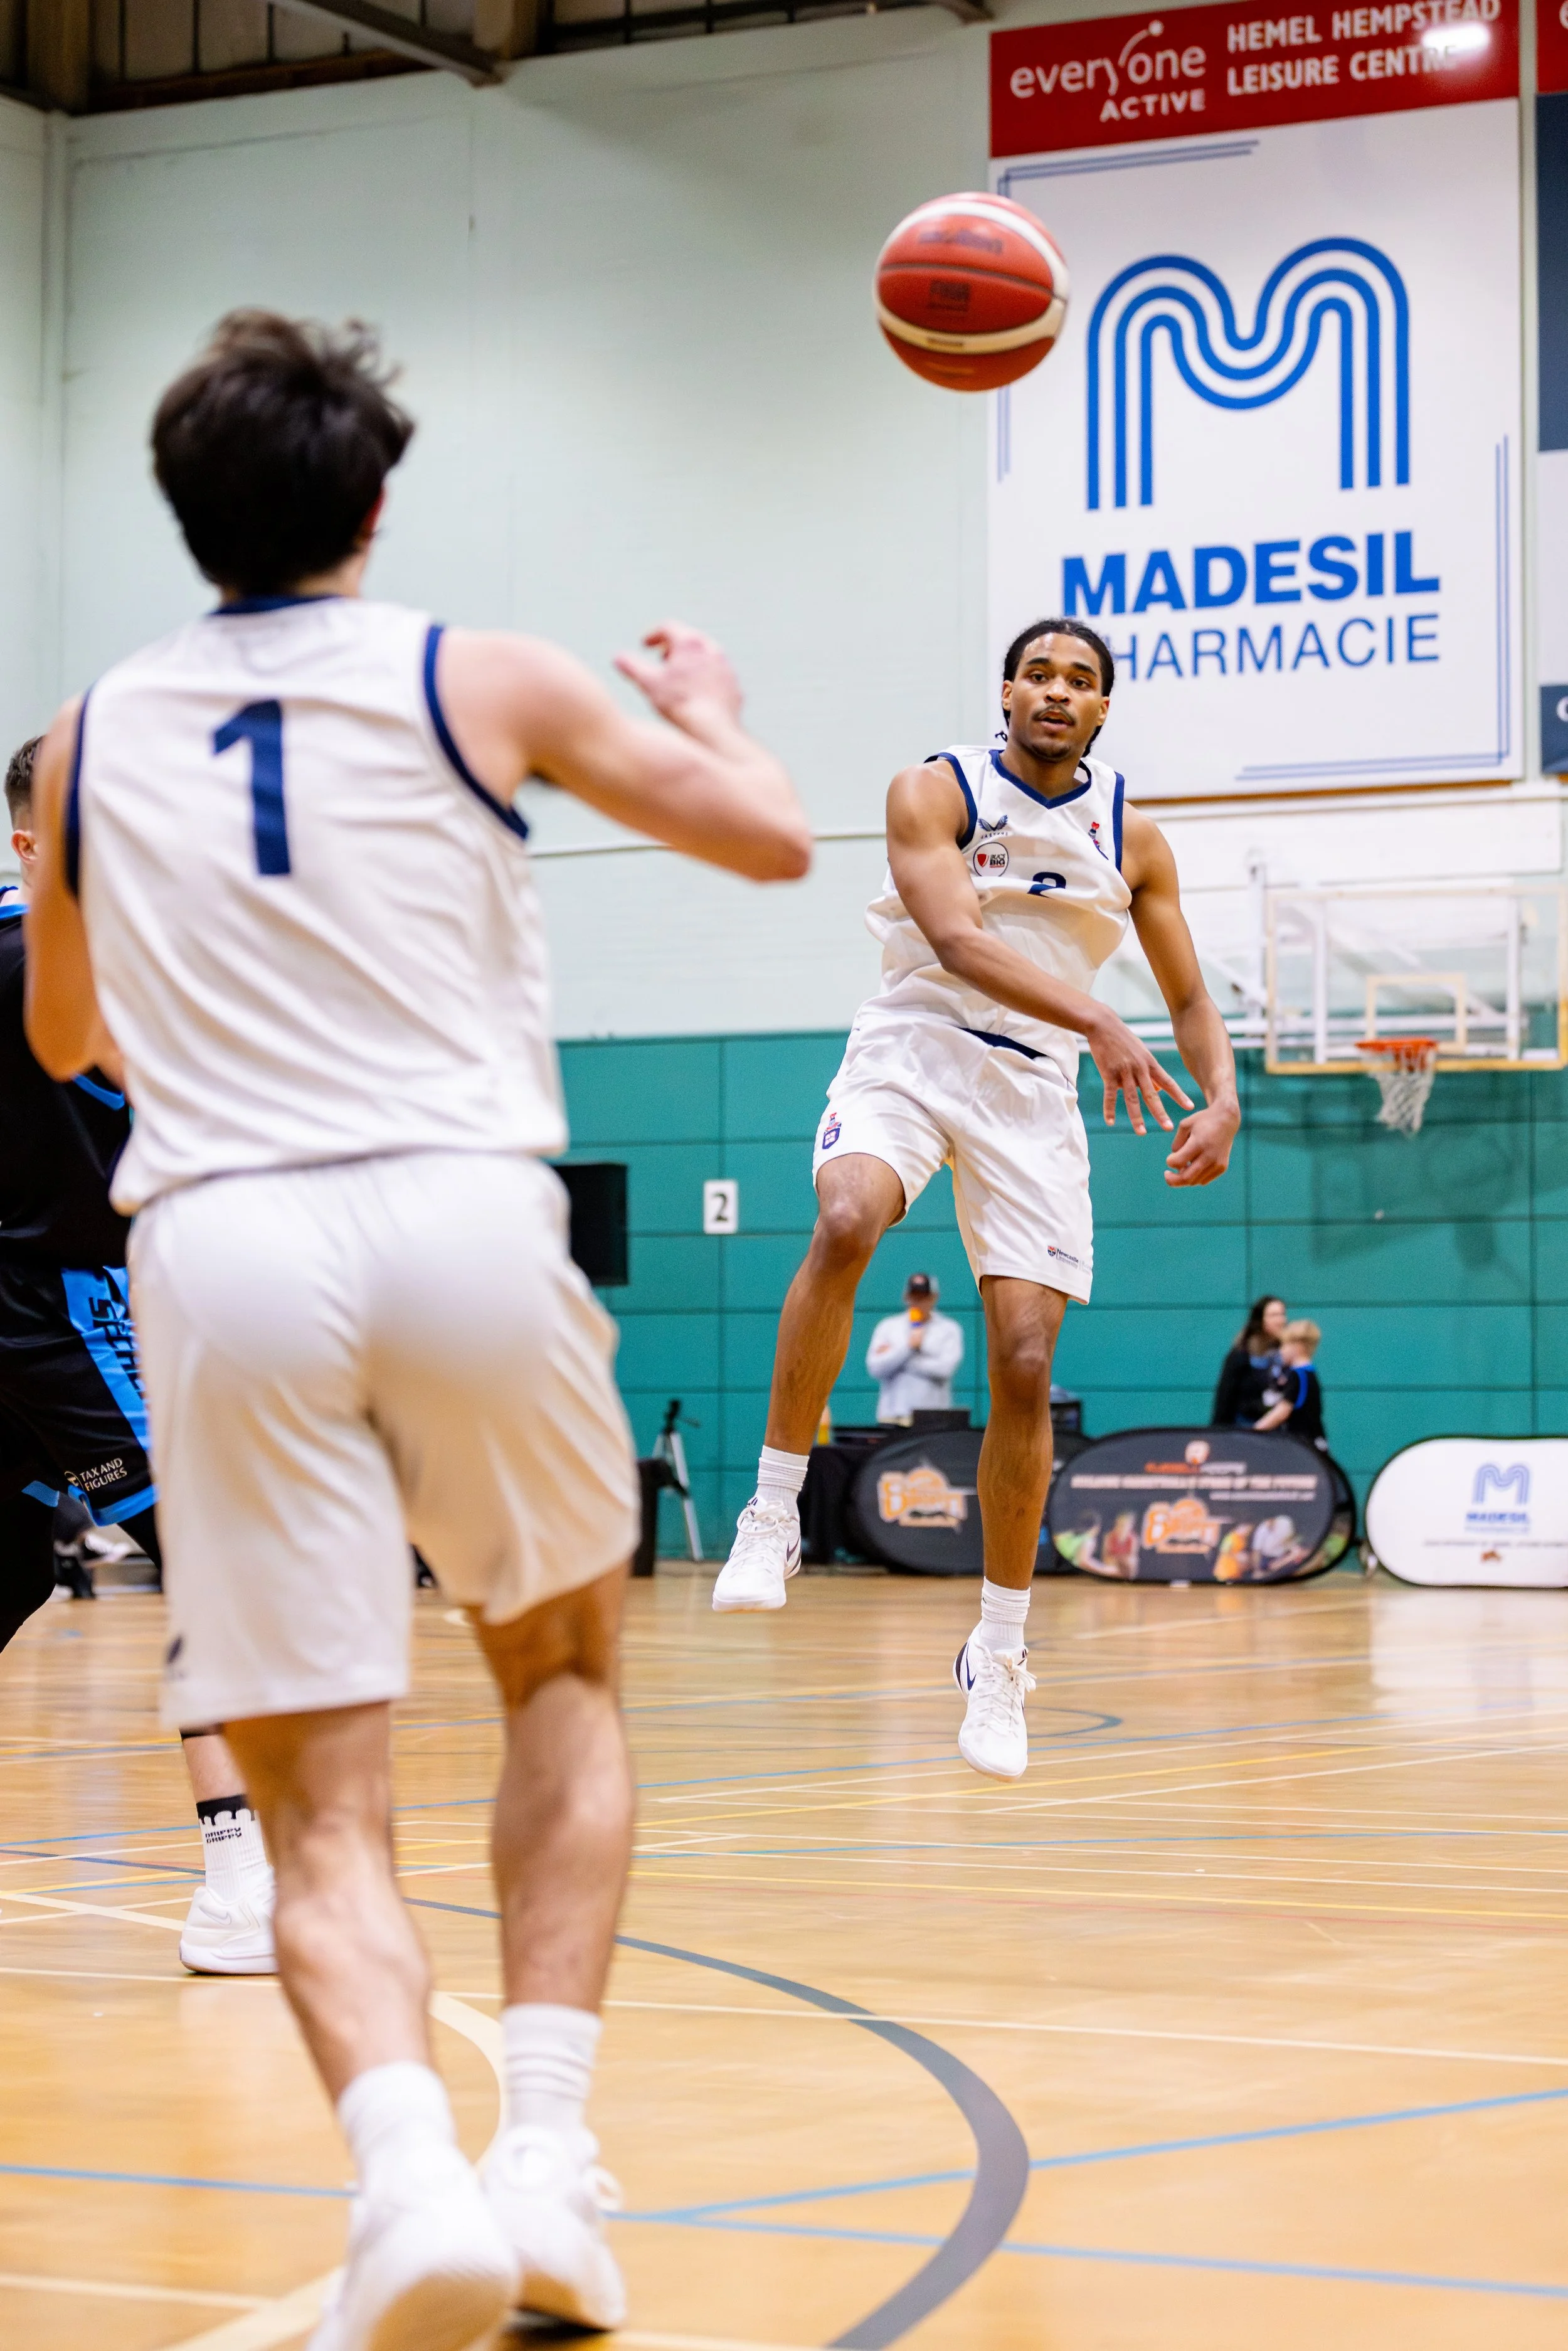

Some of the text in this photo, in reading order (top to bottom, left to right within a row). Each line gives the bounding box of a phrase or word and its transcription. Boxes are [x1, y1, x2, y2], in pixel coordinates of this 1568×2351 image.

[1227, 0, 1502, 53] HEMEL HEMPSTEAD
[1010, 20, 1207, 99] everyone
[1227, 44, 1459, 97] LEISURE CENTRE
[1099, 88, 1207, 123] ACTIVE
[1062, 530, 1441, 618] MADESIL
[1106, 613, 1441, 681] HARMACIE
[211, 699, 292, 875] 1
[711, 1192, 728, 1223] 2
[1057, 1248, 1079, 1263] Newcastle
[80, 1458, 124, 1482] TAX AND
[84, 1467, 128, 1492] FIGURES
